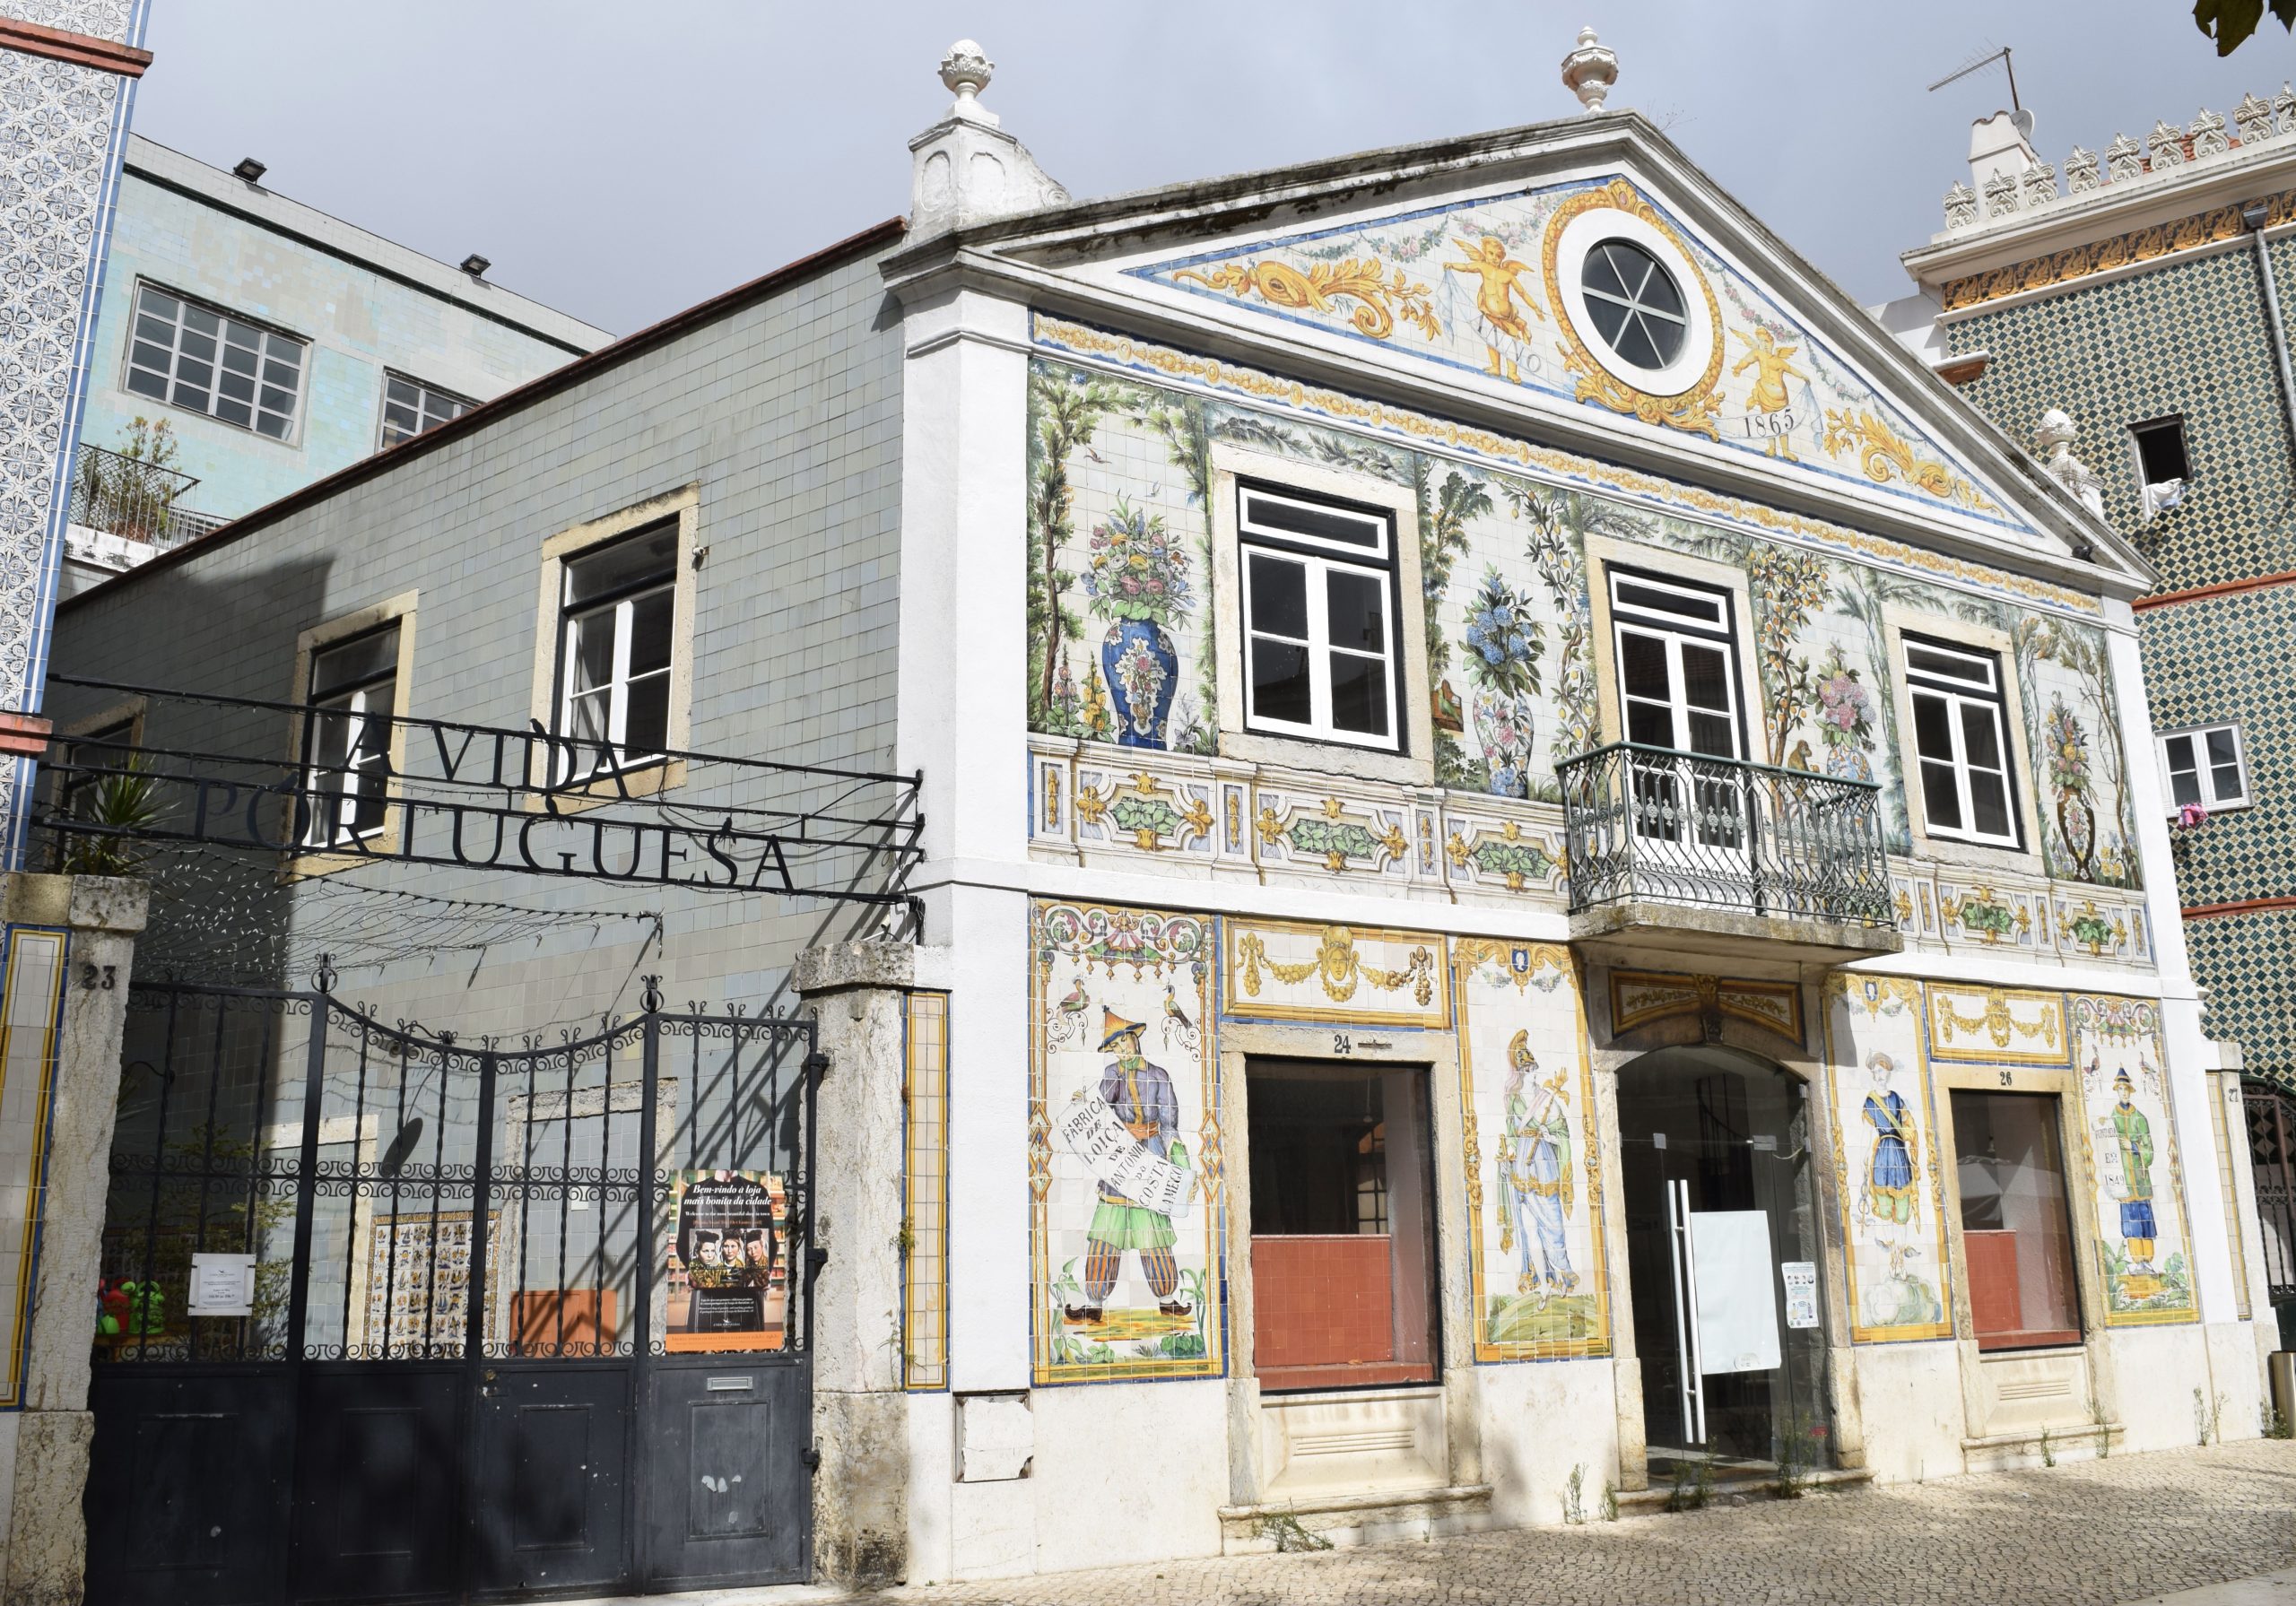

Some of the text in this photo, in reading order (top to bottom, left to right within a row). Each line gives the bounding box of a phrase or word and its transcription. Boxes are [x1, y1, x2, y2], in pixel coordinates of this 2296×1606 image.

[1744, 409, 1794, 437] 1865
[340, 712, 632, 800] A VIDA
[194, 777, 797, 894] PORTUGUESA
[82, 964, 117, 990] 23
[1334, 1034, 1351, 1054] 24
[2000, 1071, 2013, 1086] 26
[1062, 1096, 1108, 1144] FABRICA
[1085, 1119, 1102, 1141] DE
[1083, 1121, 1125, 1165] LOIÇA
[1108, 1145, 1126, 1161] DE
[1109, 1141, 1147, 1191] ANTONIO
[693, 1185, 736, 1194] Bem-vindo
[745, 1185, 761, 1196] loja
[1138, 1159, 1169, 1208] COSTA
[1159, 1166, 1184, 1216] LAMEGO
[2104, 1174, 2125, 1186] 1849
[683, 1195, 772, 1205] mais bonita da cidade
